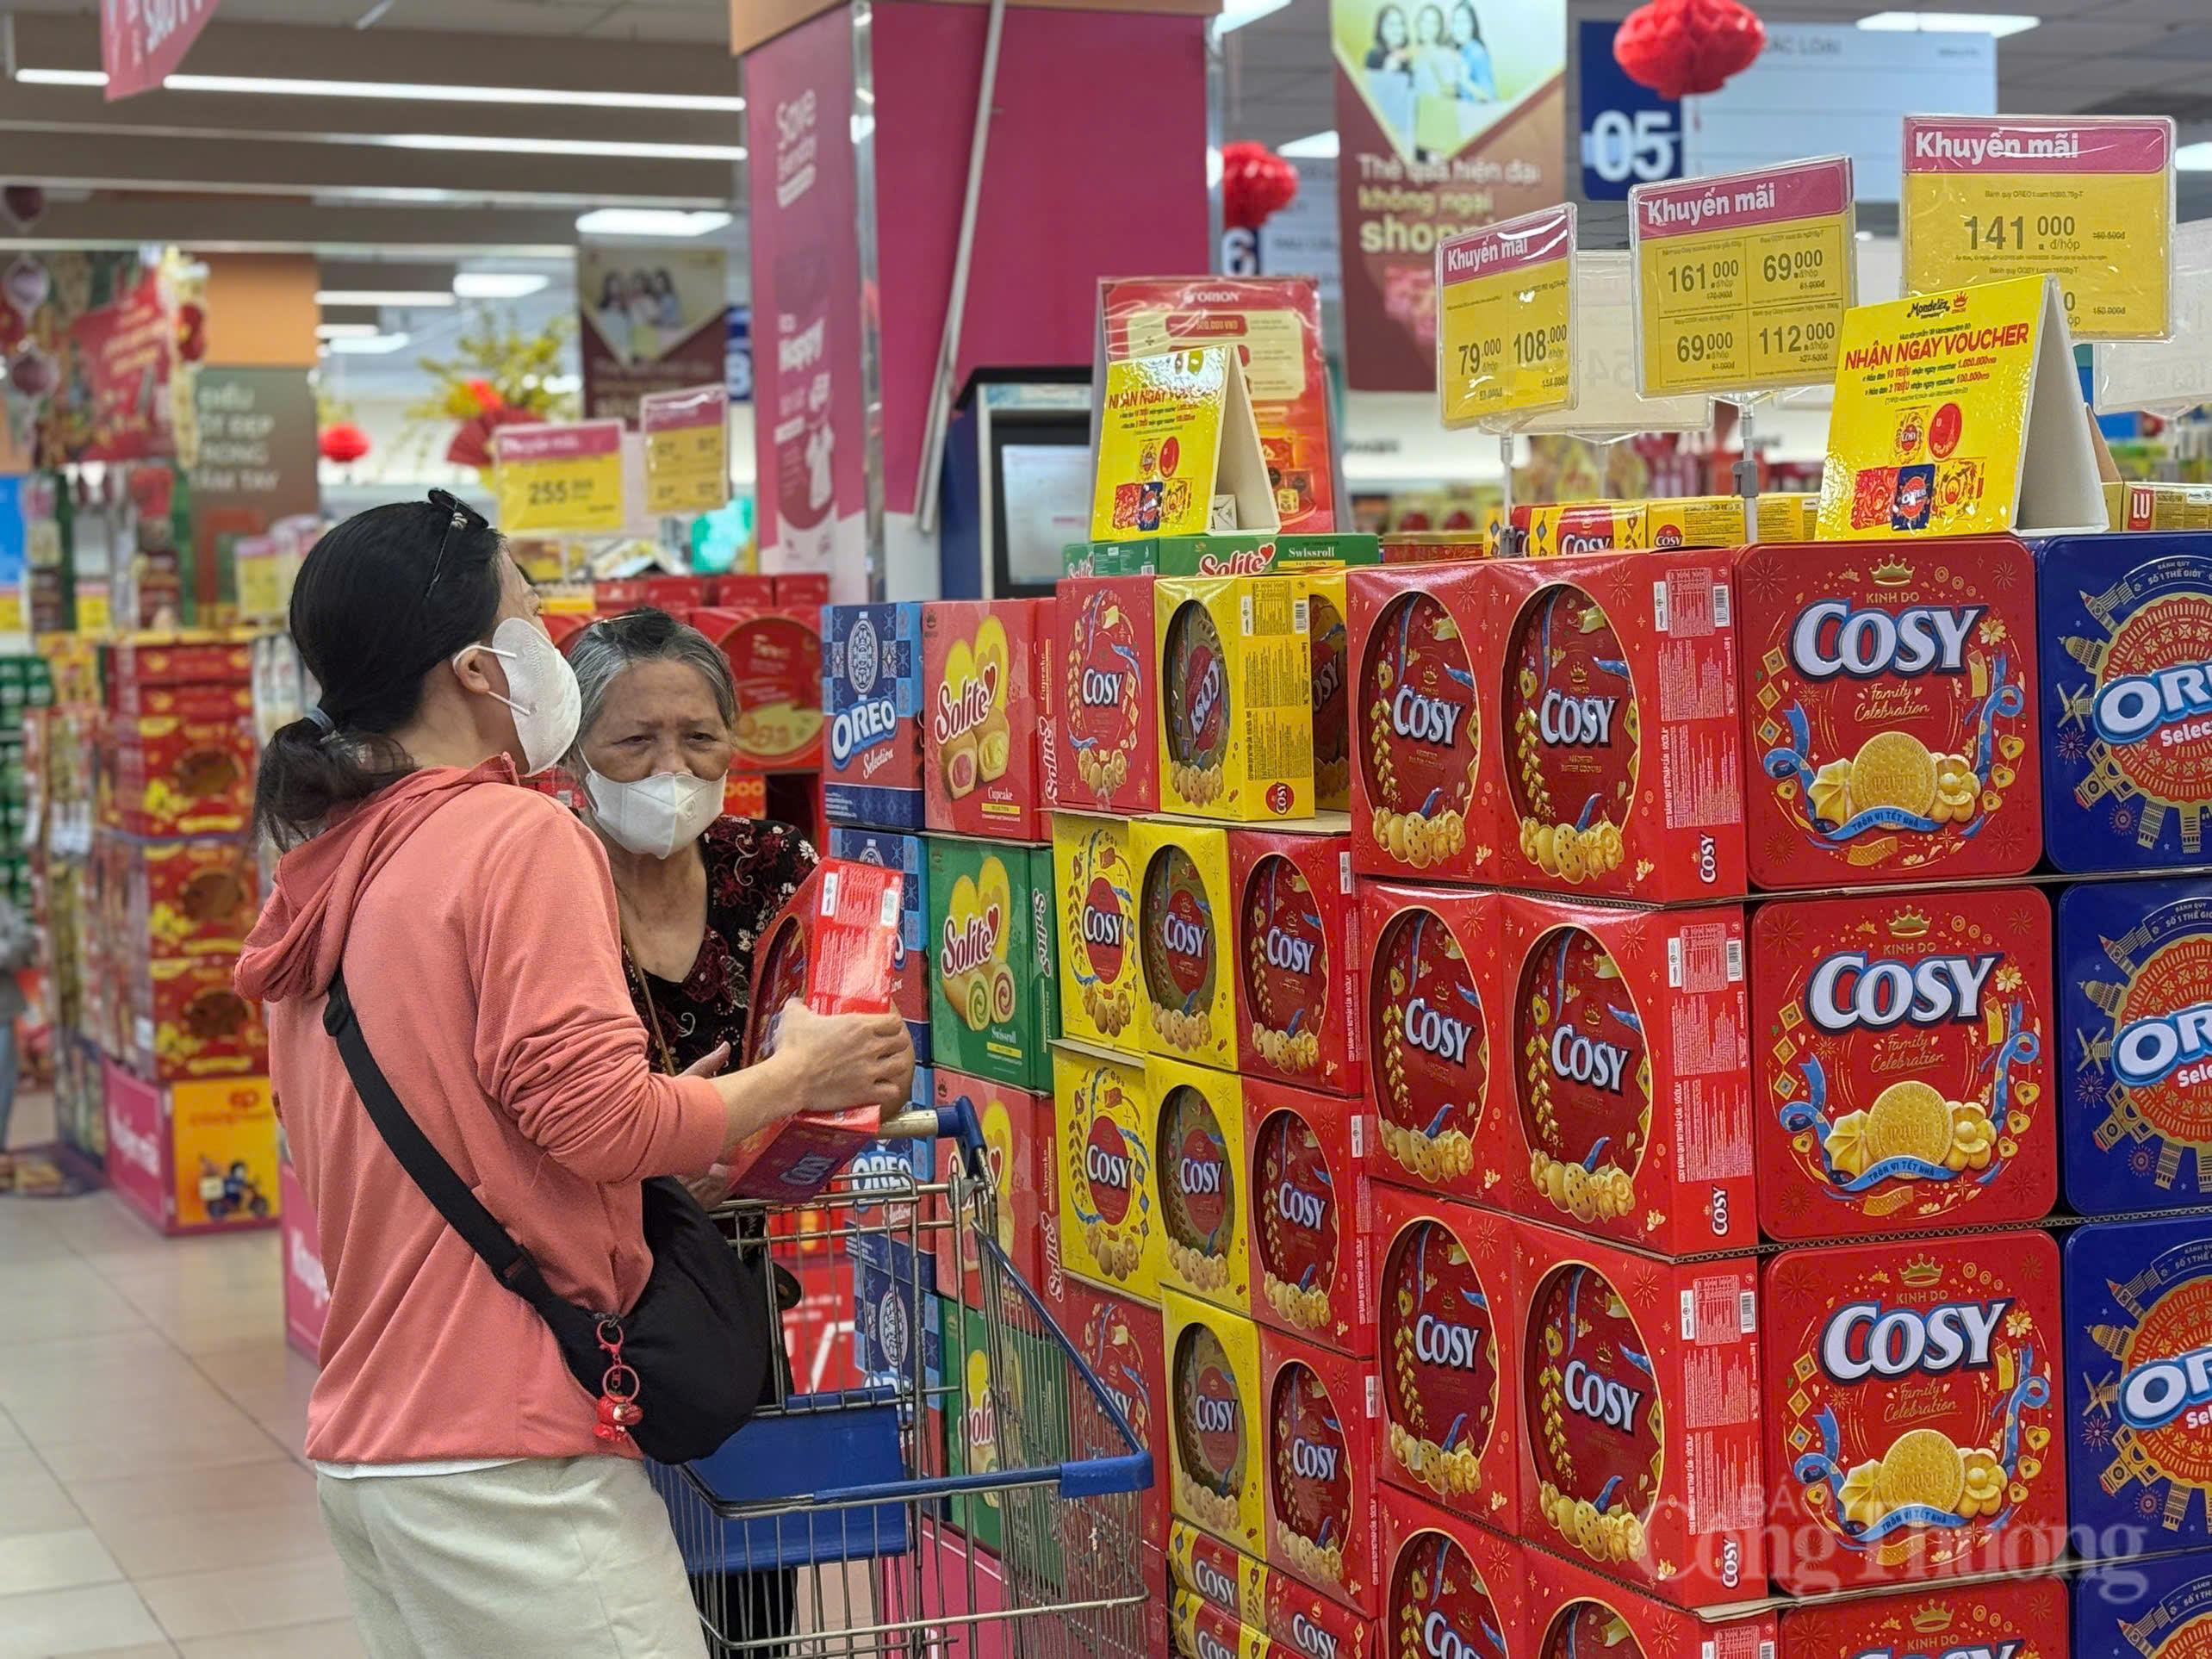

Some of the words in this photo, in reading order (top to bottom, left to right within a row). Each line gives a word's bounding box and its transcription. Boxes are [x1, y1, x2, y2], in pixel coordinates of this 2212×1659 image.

[1591, 109, 1675, 182] 05
[1915, 127, 2022, 165] Khuyến
[2028, 132, 2079, 158] mãi
[1647, 186, 1730, 227] Khuyến
[1735, 183, 1776, 214] mãi
[1448, 234, 1499, 272] Khuyến
[2049, 239, 2080, 251] đ/hộp
[1844, 340, 1893, 371] NHẬN
[1896, 336, 1943, 363] NGAY
[1944, 322, 2029, 356] VOUCHER
[2132, 494, 2152, 519] LU
[1200, 550, 1264, 576] Solite
[1289, 546, 1335, 557] Swissroll
[1655, 535, 1682, 547] COSY
[1866, 593, 1897, 603] KINH
[1793, 602, 1979, 676] COSY
[1082, 668, 1124, 706] COSY
[1871, 680, 1913, 702] Family
[2101, 665, 2212, 732] OR
[832, 699, 896, 761] OREO
[935, 676, 989, 744] Solite
[1392, 687, 1463, 746] COSY
[1540, 689, 1619, 745] COSY
[1854, 700, 1930, 722] Celebration
[2160, 721, 2212, 747] Selec
[863, 748, 894, 780] Selection
[1275, 784, 1288, 815] COSY
[1700, 835, 1717, 885] COSY
[942, 916, 991, 977] Solite
[1084, 905, 1123, 946] COSY
[1163, 911, 1209, 958] COSY
[1267, 928, 1314, 973] COSY
[1883, 944, 1913, 955] KINH
[1810, 955, 1995, 1028] COSY
[1404, 997, 1473, 1065] COSY
[1887, 1033, 1929, 1056] Family
[1550, 1023, 1629, 1093] COSY
[1870, 1053, 1945, 1073] Celebration
[1086, 1144, 1131, 1189] COSY
[1179, 1158, 1223, 1194] COSY
[1279, 1181, 1326, 1231] COSY
[1711, 1186, 1729, 1236] COSY
[1895, 1291, 1928, 1304] KINH
[1414, 1314, 1479, 1370] COSY
[1824, 1303, 2005, 1379] COSY
[1196, 1398, 1237, 1433] COSY
[1564, 1360, 1639, 1432] COSY
[1883, 1402, 1957, 1423] Celebration
[1899, 1383, 1941, 1409] Family
[1293, 1438, 1338, 1482] COSY
[1195, 1559, 1237, 1607] COSY
[1722, 1538, 1739, 1588] COSY
[1293, 1613, 1337, 1659] COSY
[1425, 1611, 1481, 1659] CO
[1907, 1637, 1935, 1650] KINH
